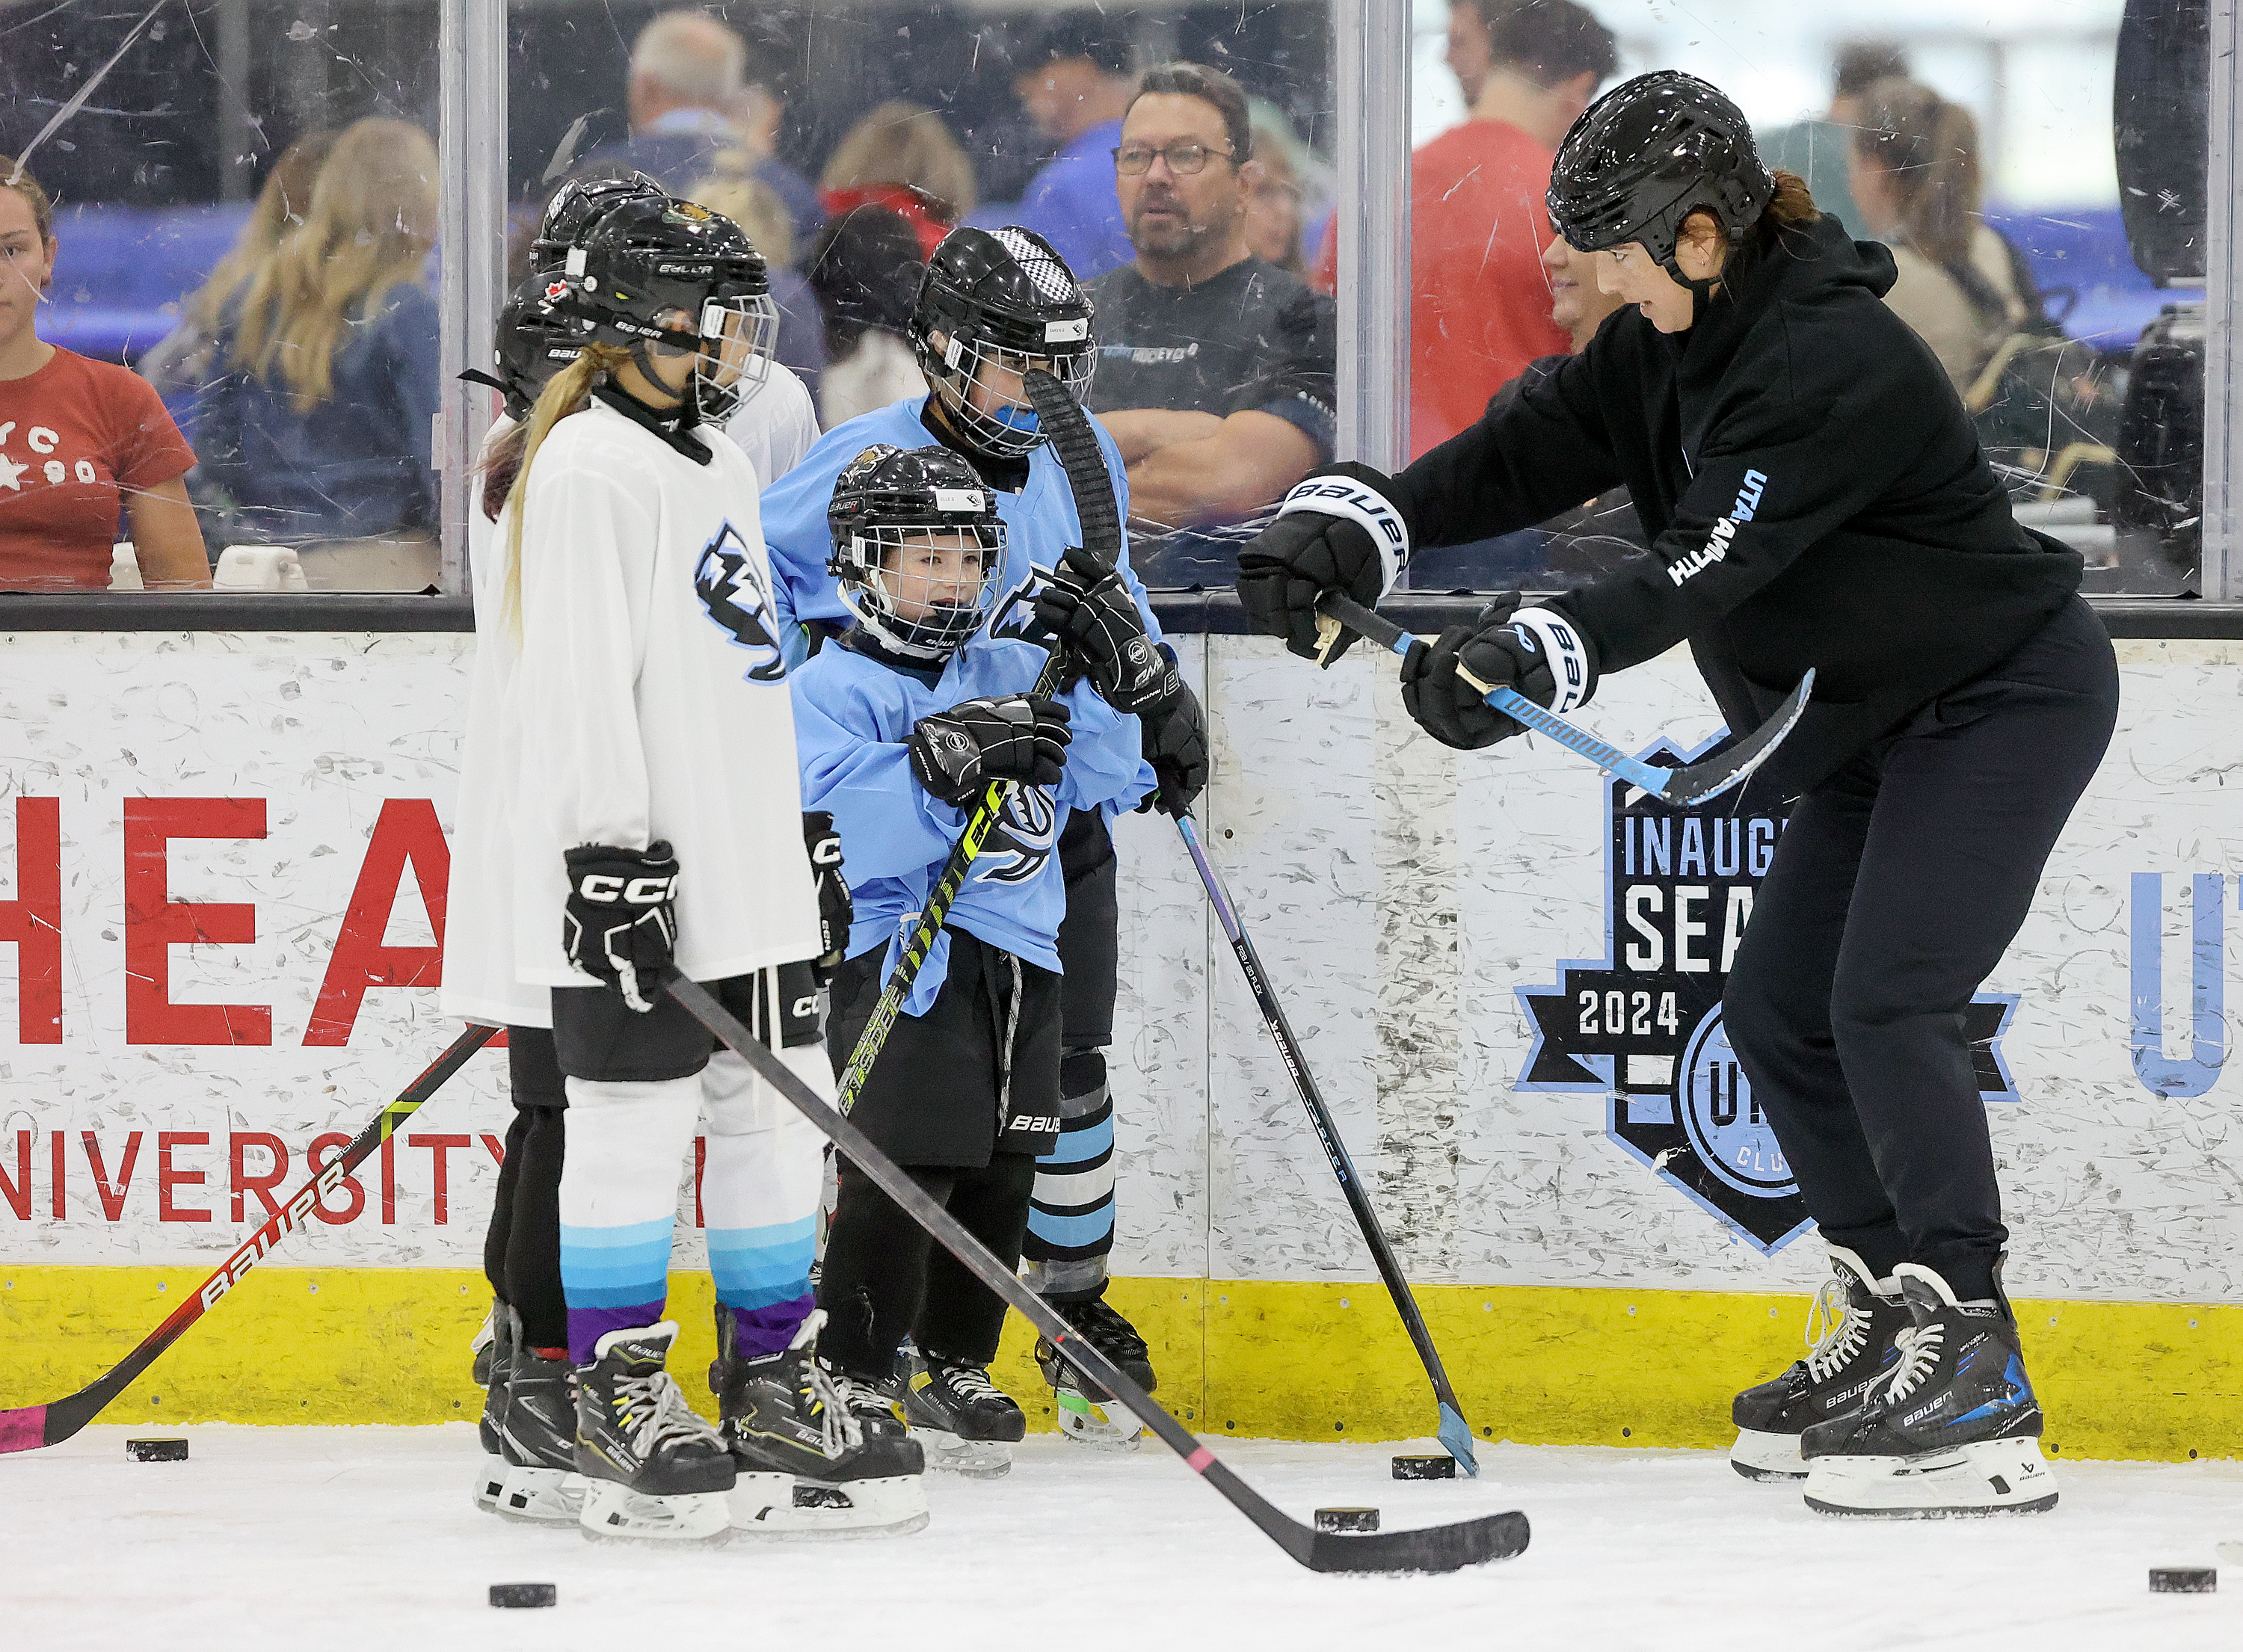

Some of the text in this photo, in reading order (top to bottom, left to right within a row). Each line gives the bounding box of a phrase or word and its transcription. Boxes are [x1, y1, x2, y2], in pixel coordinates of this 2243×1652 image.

[547, 348, 582, 359] BAU
[1286, 484, 1407, 575] BAUER
[1546, 622, 1581, 715] BAU
[1503, 695, 1625, 768] WARRIOR
[961, 781, 1011, 862] CC
[1625, 816, 1789, 876] INAUG
[579, 874, 677, 904] CC
[1625, 884, 1755, 973] SEA
[1250, 975, 1264, 996] FLEX
[1578, 990, 1679, 1036] 2024
[2131, 872, 2243, 1098] U
[838, 985, 906, 1119] ETSPEE
[1008, 1115, 1060, 1133] BAUE
[1735, 1145, 1784, 1173] CLU
[200, 1161, 346, 1313] BAUER
[1904, 1390, 1954, 1427] BAUER
[2019, 1471, 2046, 1482] BAUER
